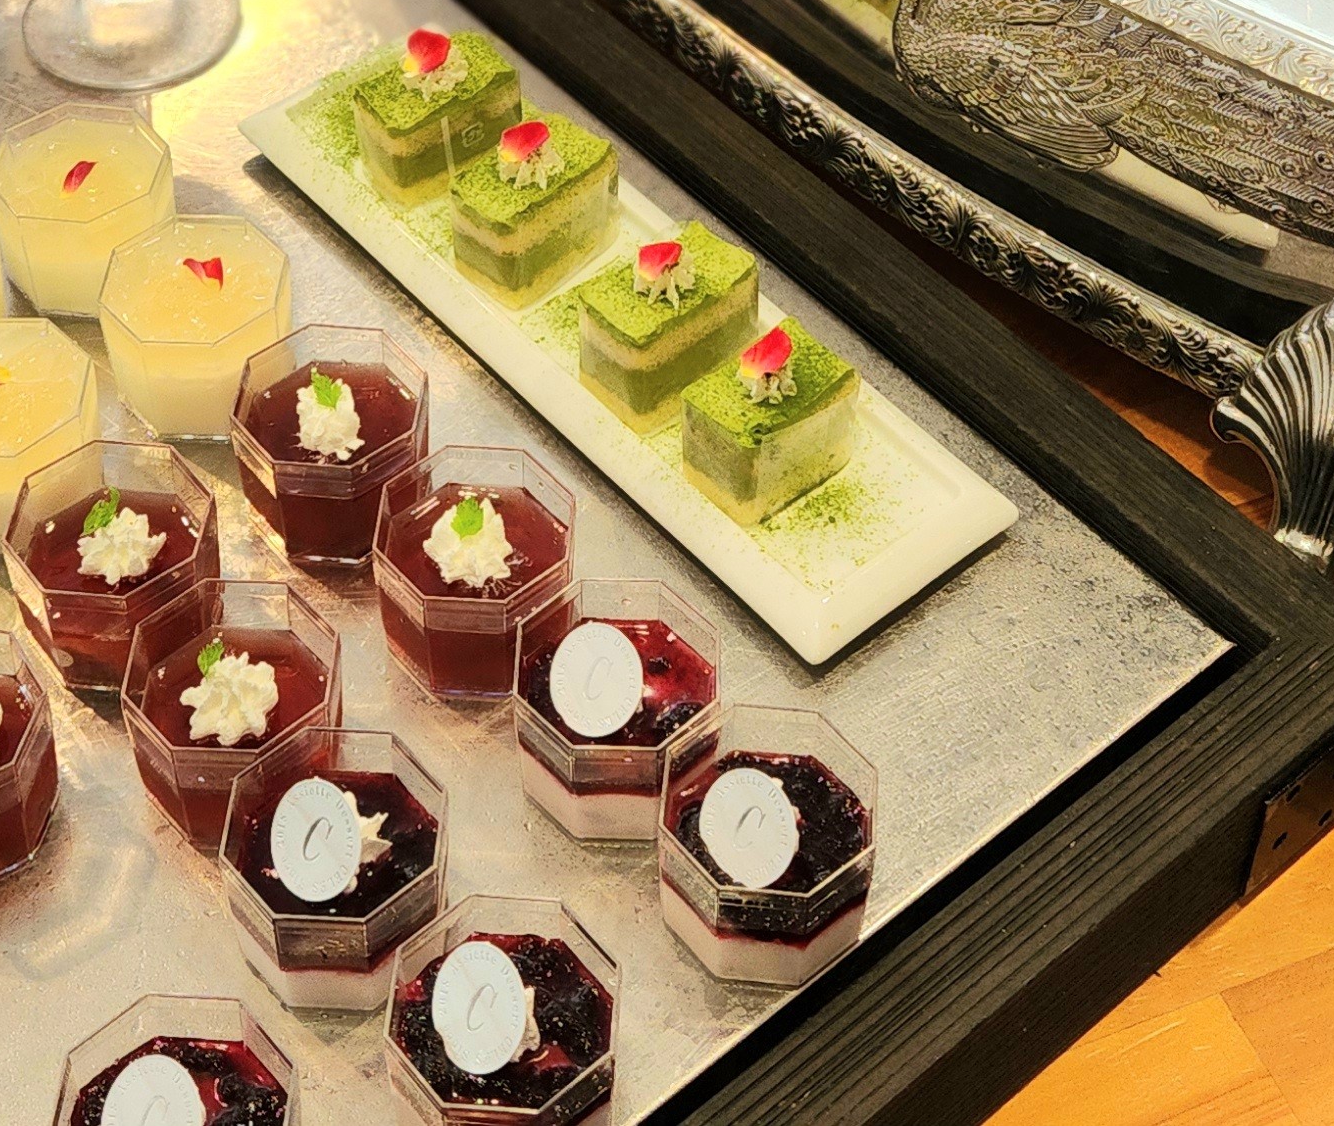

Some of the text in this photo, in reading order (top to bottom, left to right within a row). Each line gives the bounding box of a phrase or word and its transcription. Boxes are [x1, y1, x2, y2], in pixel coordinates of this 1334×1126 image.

[581, 656, 614, 701] C
[302, 816, 334, 862] C
[733, 805, 767, 850] C
[466, 982, 499, 1032] C
